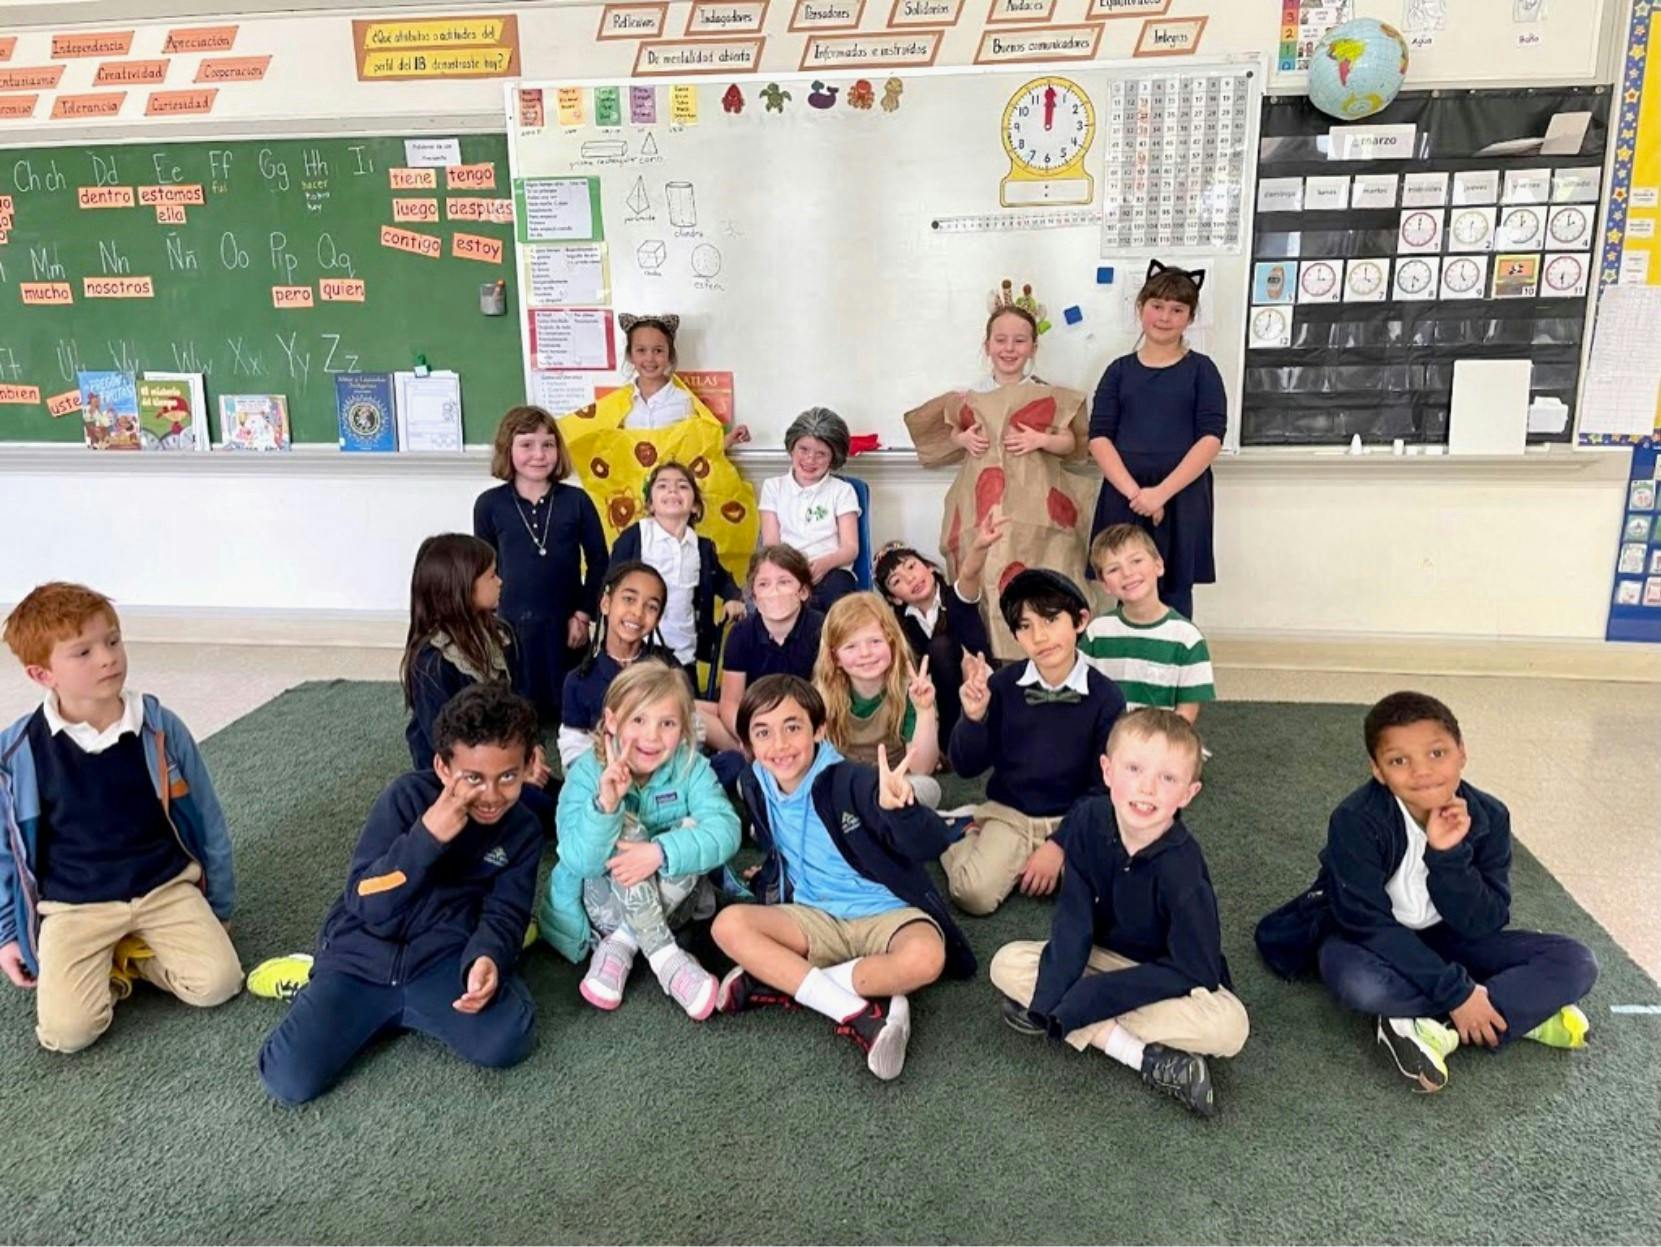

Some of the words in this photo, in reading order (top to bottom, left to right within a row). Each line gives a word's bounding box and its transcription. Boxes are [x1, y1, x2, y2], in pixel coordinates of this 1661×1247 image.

[904, 1, 949, 15] Solidarios
[700, 9, 752, 27] Indagadores
[482, 25, 494, 39] del
[52, 39, 124, 55] Independencia
[993, 38, 1025, 54] Buenos
[1028, 38, 1090, 53] comunicadores
[1412, 37, 1433, 47] Agua
[648, 51, 660, 64] De
[663, 50, 713, 63] mentalidad
[719, 49, 750, 62] abierta
[815, 43, 867, 61] Informados
[872, 48, 878, 57] e
[374, 57, 393, 72] perfil
[399, 57, 411, 71] del
[414, 56, 426, 71] IB
[98, 65, 163, 81] Creatividad
[62, 99, 118, 114] Tolerancia
[152, 96, 209, 112] Curiosidad
[1032, 95, 1039, 105] 11
[1062, 94, 1067, 103] 1
[1019, 107, 1030, 117] 10
[1072, 104, 1079, 114] 2
[1014, 123, 1020, 132] 9
[1077, 121, 1083, 131] 3
[1018, 139, 1025, 149] 8
[1071, 137, 1077, 146] 4
[1361, 136, 1396, 146] marzo
[348, 146, 373, 174] Ii
[1030, 150, 1036, 160] 7
[1044, 153, 1050, 163] 6
[1060, 148, 1067, 158] 5
[92, 154, 119, 186] Dd
[154, 153, 184, 184] Ee
[208, 150, 233, 179] Ff
[259, 148, 289, 190] Gg
[303, 149, 328, 176] Hh
[14, 160, 41, 192] Ch
[393, 172, 432, 186] tiene
[449, 168, 492, 186] tengo
[80, 189, 131, 204] dentro
[141, 187, 200, 202] estamos
[158, 207, 184, 222] ella
[396, 200, 436, 219] luego
[383, 230, 440, 254] contigo
[457, 237, 499, 259] estoy
[100, 241, 130, 273] Nn
[166, 232, 198, 271] Ññ
[220, 232, 249, 270] Oo
[270, 232, 297, 285] Pp
[318, 232, 356, 279] Qq
[30, 247, 66, 281] Mm
[24, 284, 69, 300] mucho
[86, 279, 150, 295] nosotros
[323, 282, 365, 299] quien
[275, 289, 311, 302] pero
[276, 332, 310, 384] Yy
[321, 333, 361, 373] Zz
[683, 375, 717, 387] ATLAS
[51, 396, 80, 415] uste
